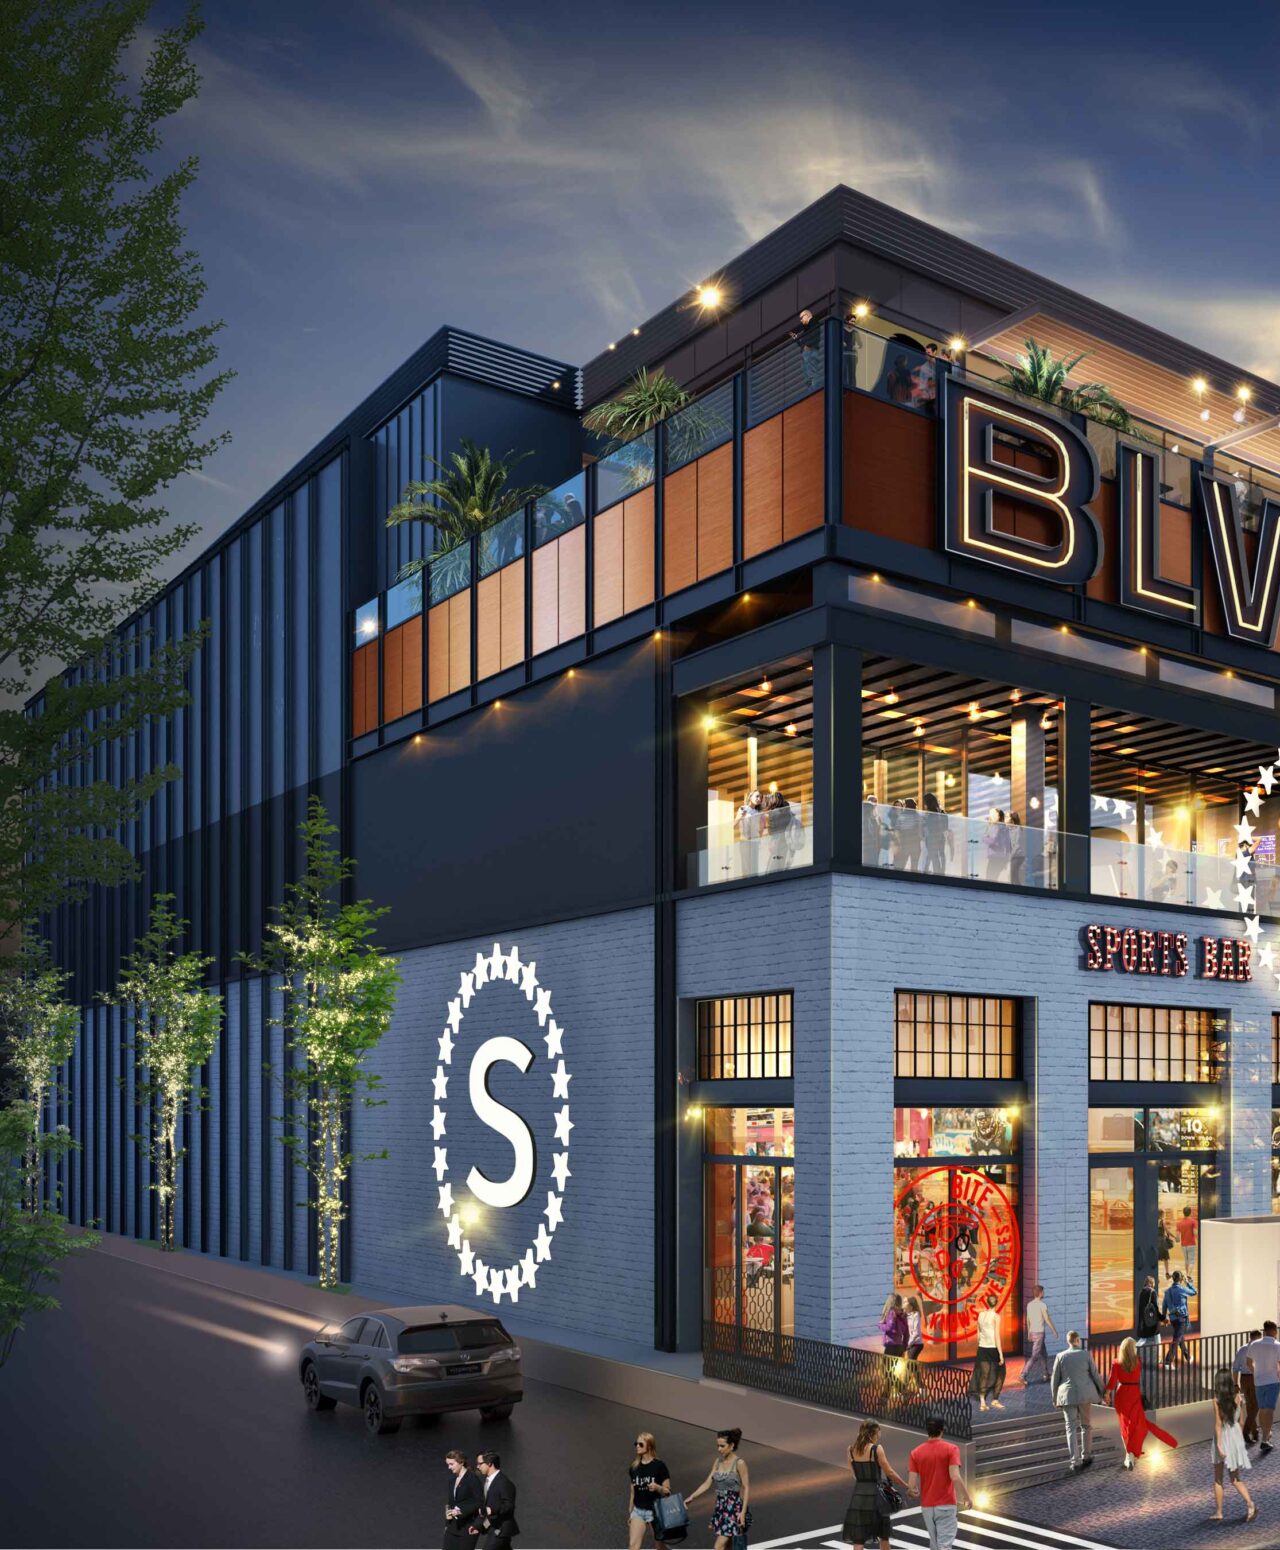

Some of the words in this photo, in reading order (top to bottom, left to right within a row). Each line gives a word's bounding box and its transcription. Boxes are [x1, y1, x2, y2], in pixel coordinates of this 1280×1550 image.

[1086, 924, 1190, 977] SPORTS
[1203, 936, 1253, 982] BAR
[466, 1036, 537, 1208] S
[951, 1174, 994, 1211] BITE
